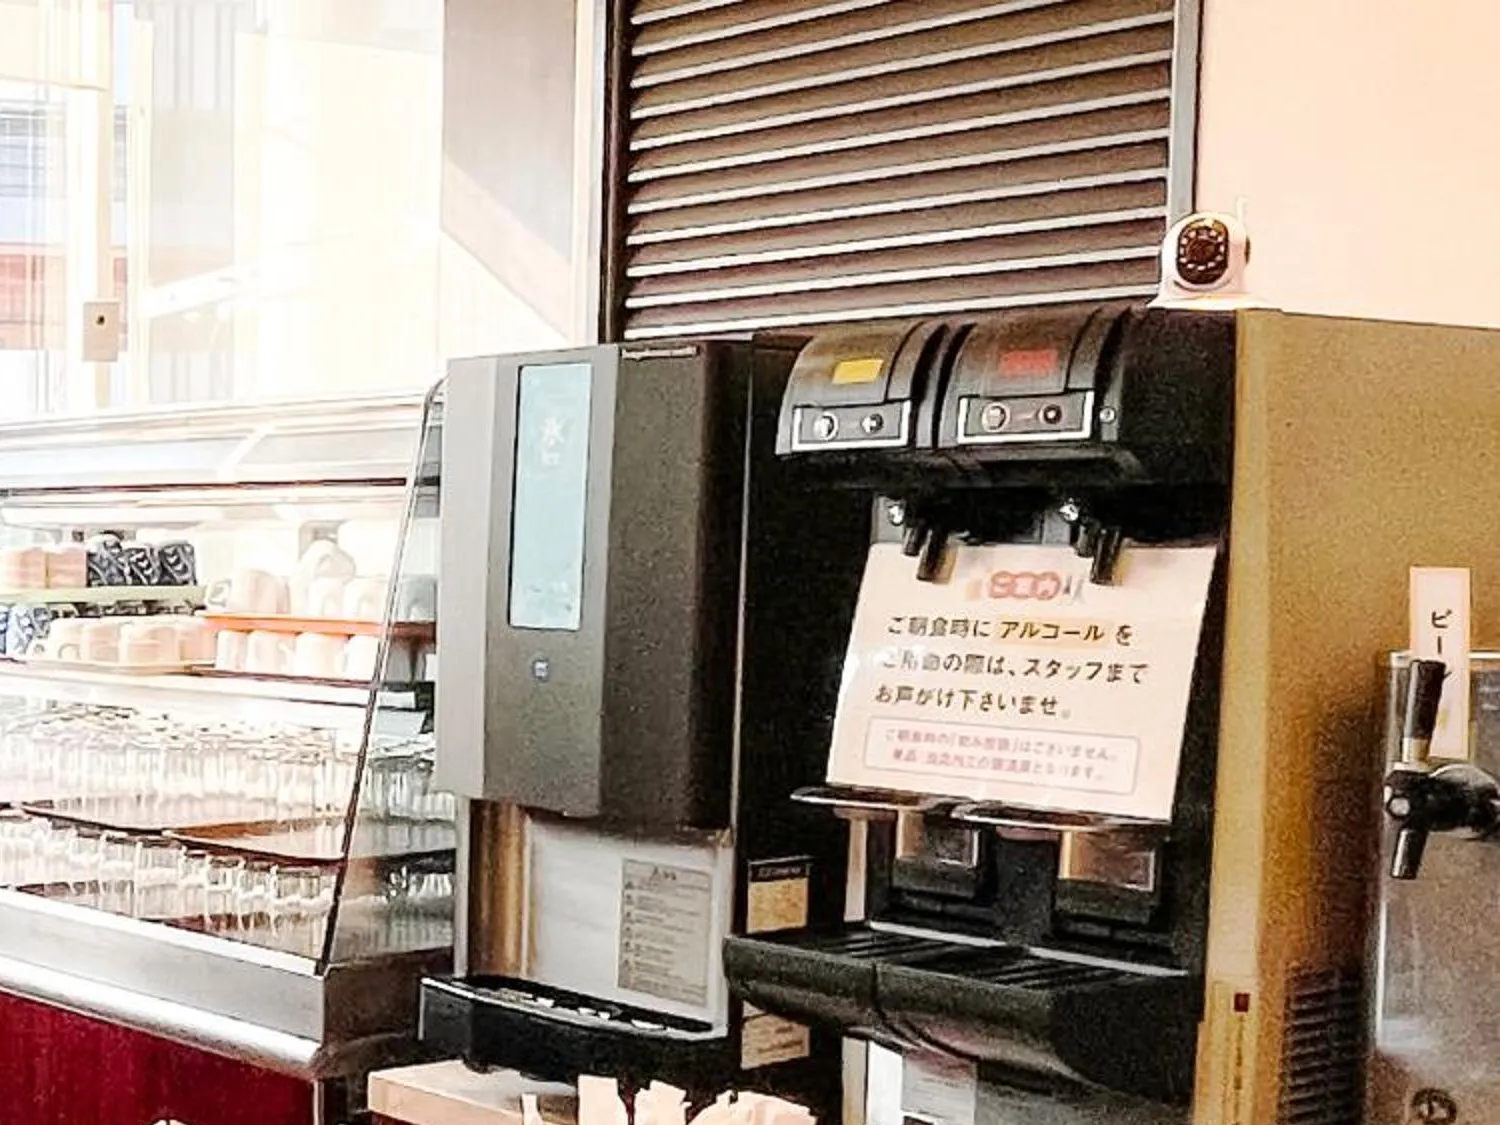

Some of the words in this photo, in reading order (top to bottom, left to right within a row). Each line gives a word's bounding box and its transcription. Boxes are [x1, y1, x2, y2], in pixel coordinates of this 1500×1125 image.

[1000, 620, 1105, 642] アルコール
[1115, 624, 1134, 647] を
